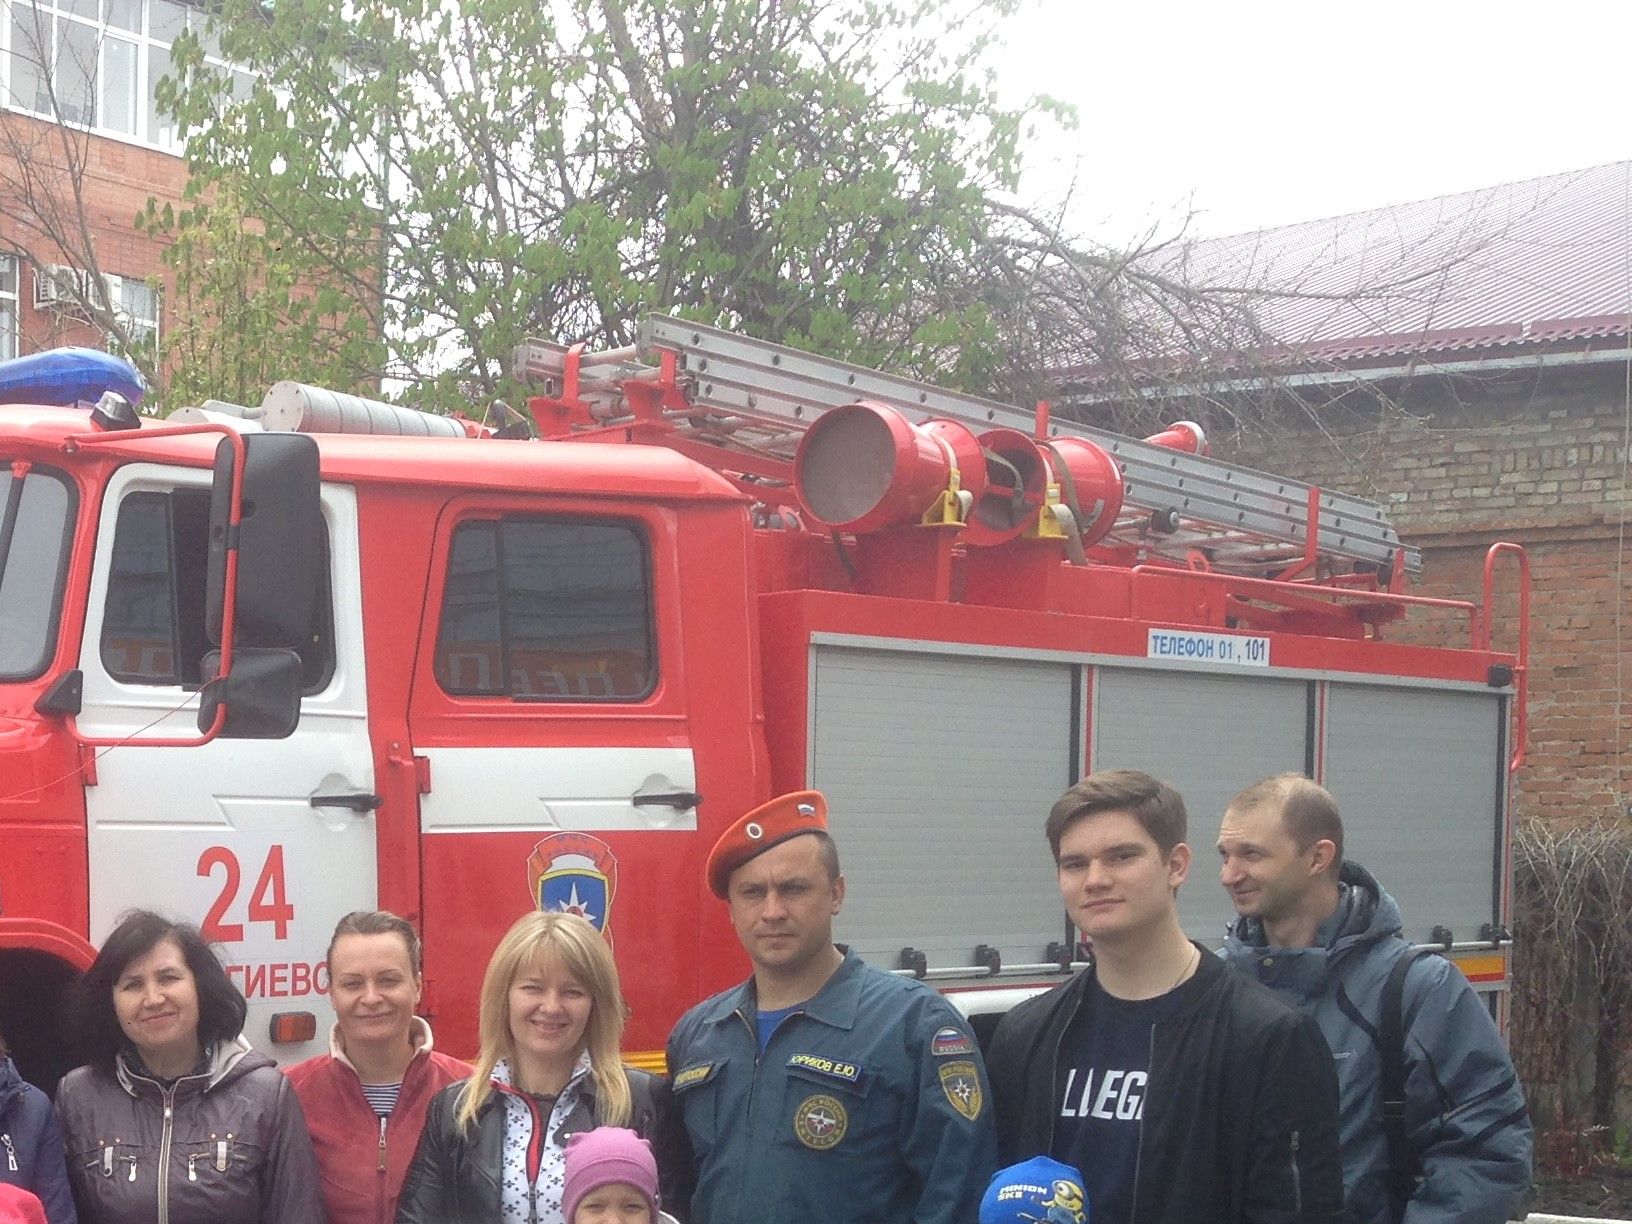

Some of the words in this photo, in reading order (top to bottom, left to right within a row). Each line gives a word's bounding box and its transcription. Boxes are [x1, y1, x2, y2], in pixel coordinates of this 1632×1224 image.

[1152, 635, 1214, 658] ТЕЛЕФОН
[1245, 639, 1265, 661] 101
[197, 844, 294, 943] 24
[1060, 1067, 1148, 1120] LLEG
[999, 1184, 1048, 1195] MINION
